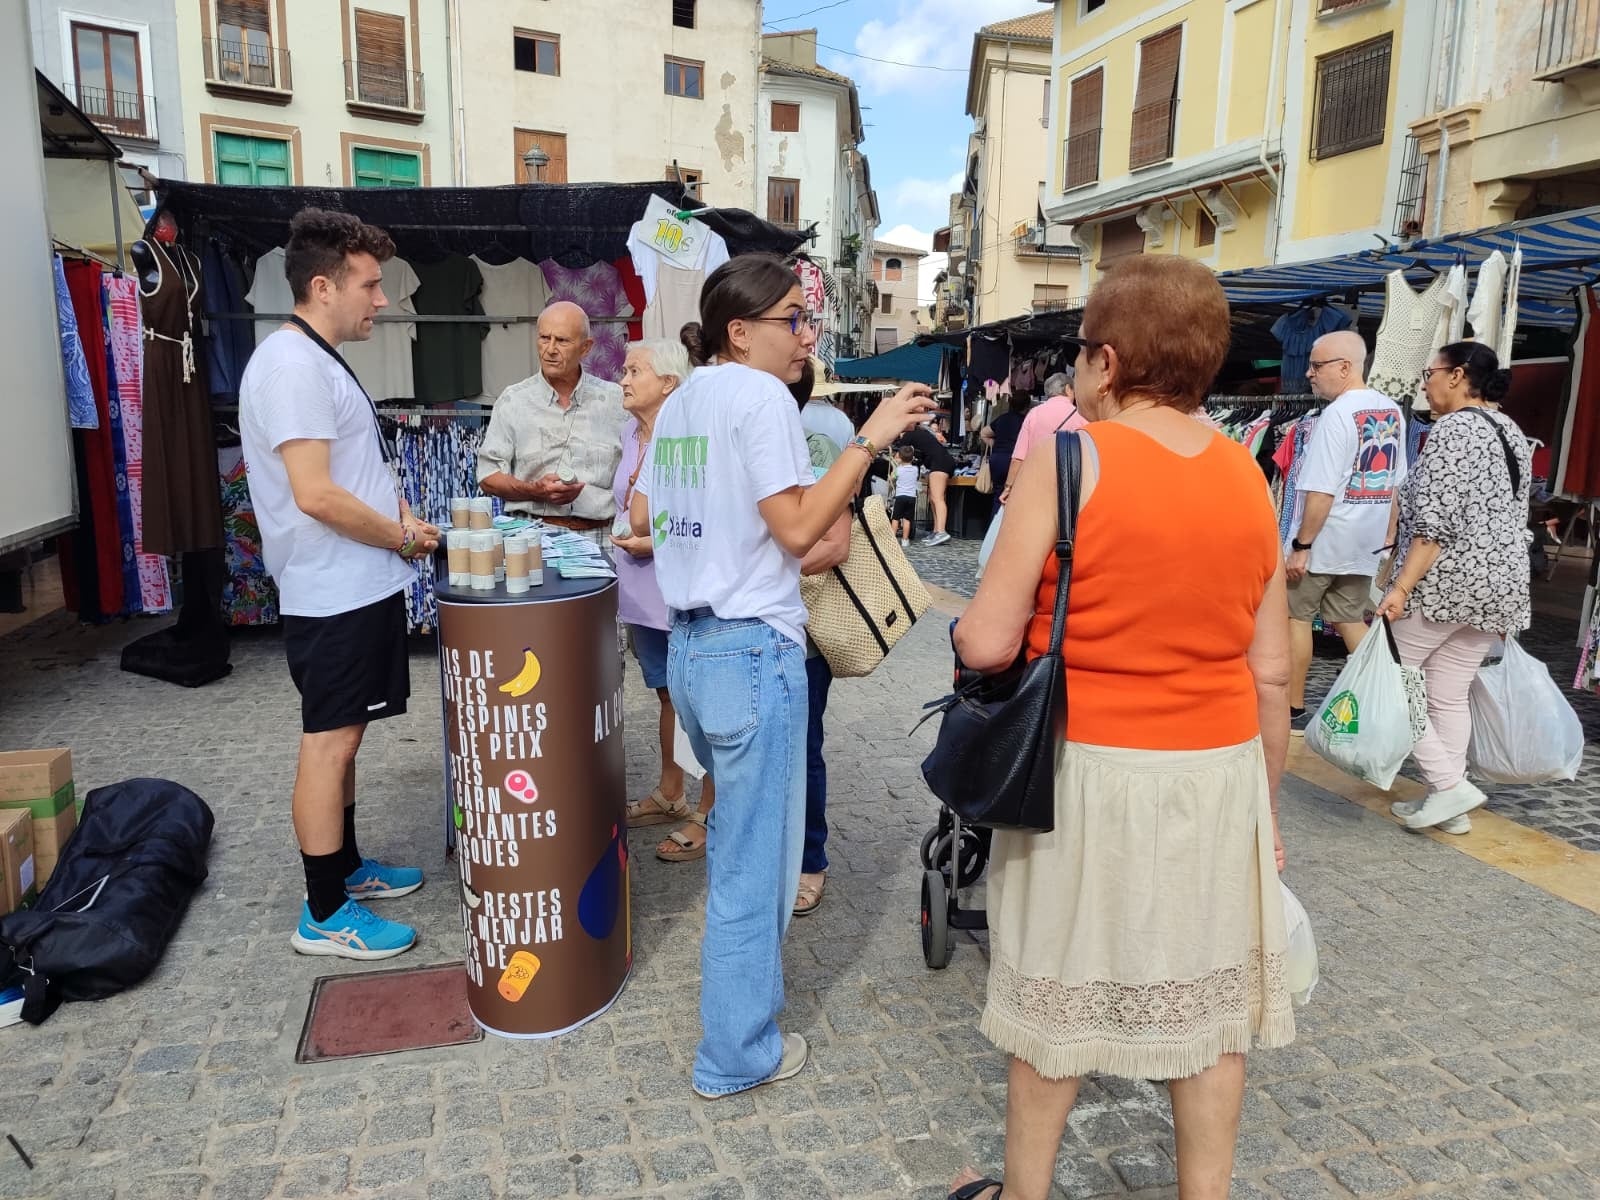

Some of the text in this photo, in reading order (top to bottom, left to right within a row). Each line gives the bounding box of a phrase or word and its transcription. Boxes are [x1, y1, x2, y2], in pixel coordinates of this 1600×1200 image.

[469, 650, 495, 678] DE
[457, 702, 547, 733] ESPINES
[594, 700, 610, 744] AL
[459, 730, 543, 760] DE PEIX
[457, 781, 501, 814] CARN
[466, 809, 557, 840] PLANTES
[483, 888, 562, 919] RESTES
[478, 914, 563, 945] MENJAR
[486, 941, 508, 970] DE
